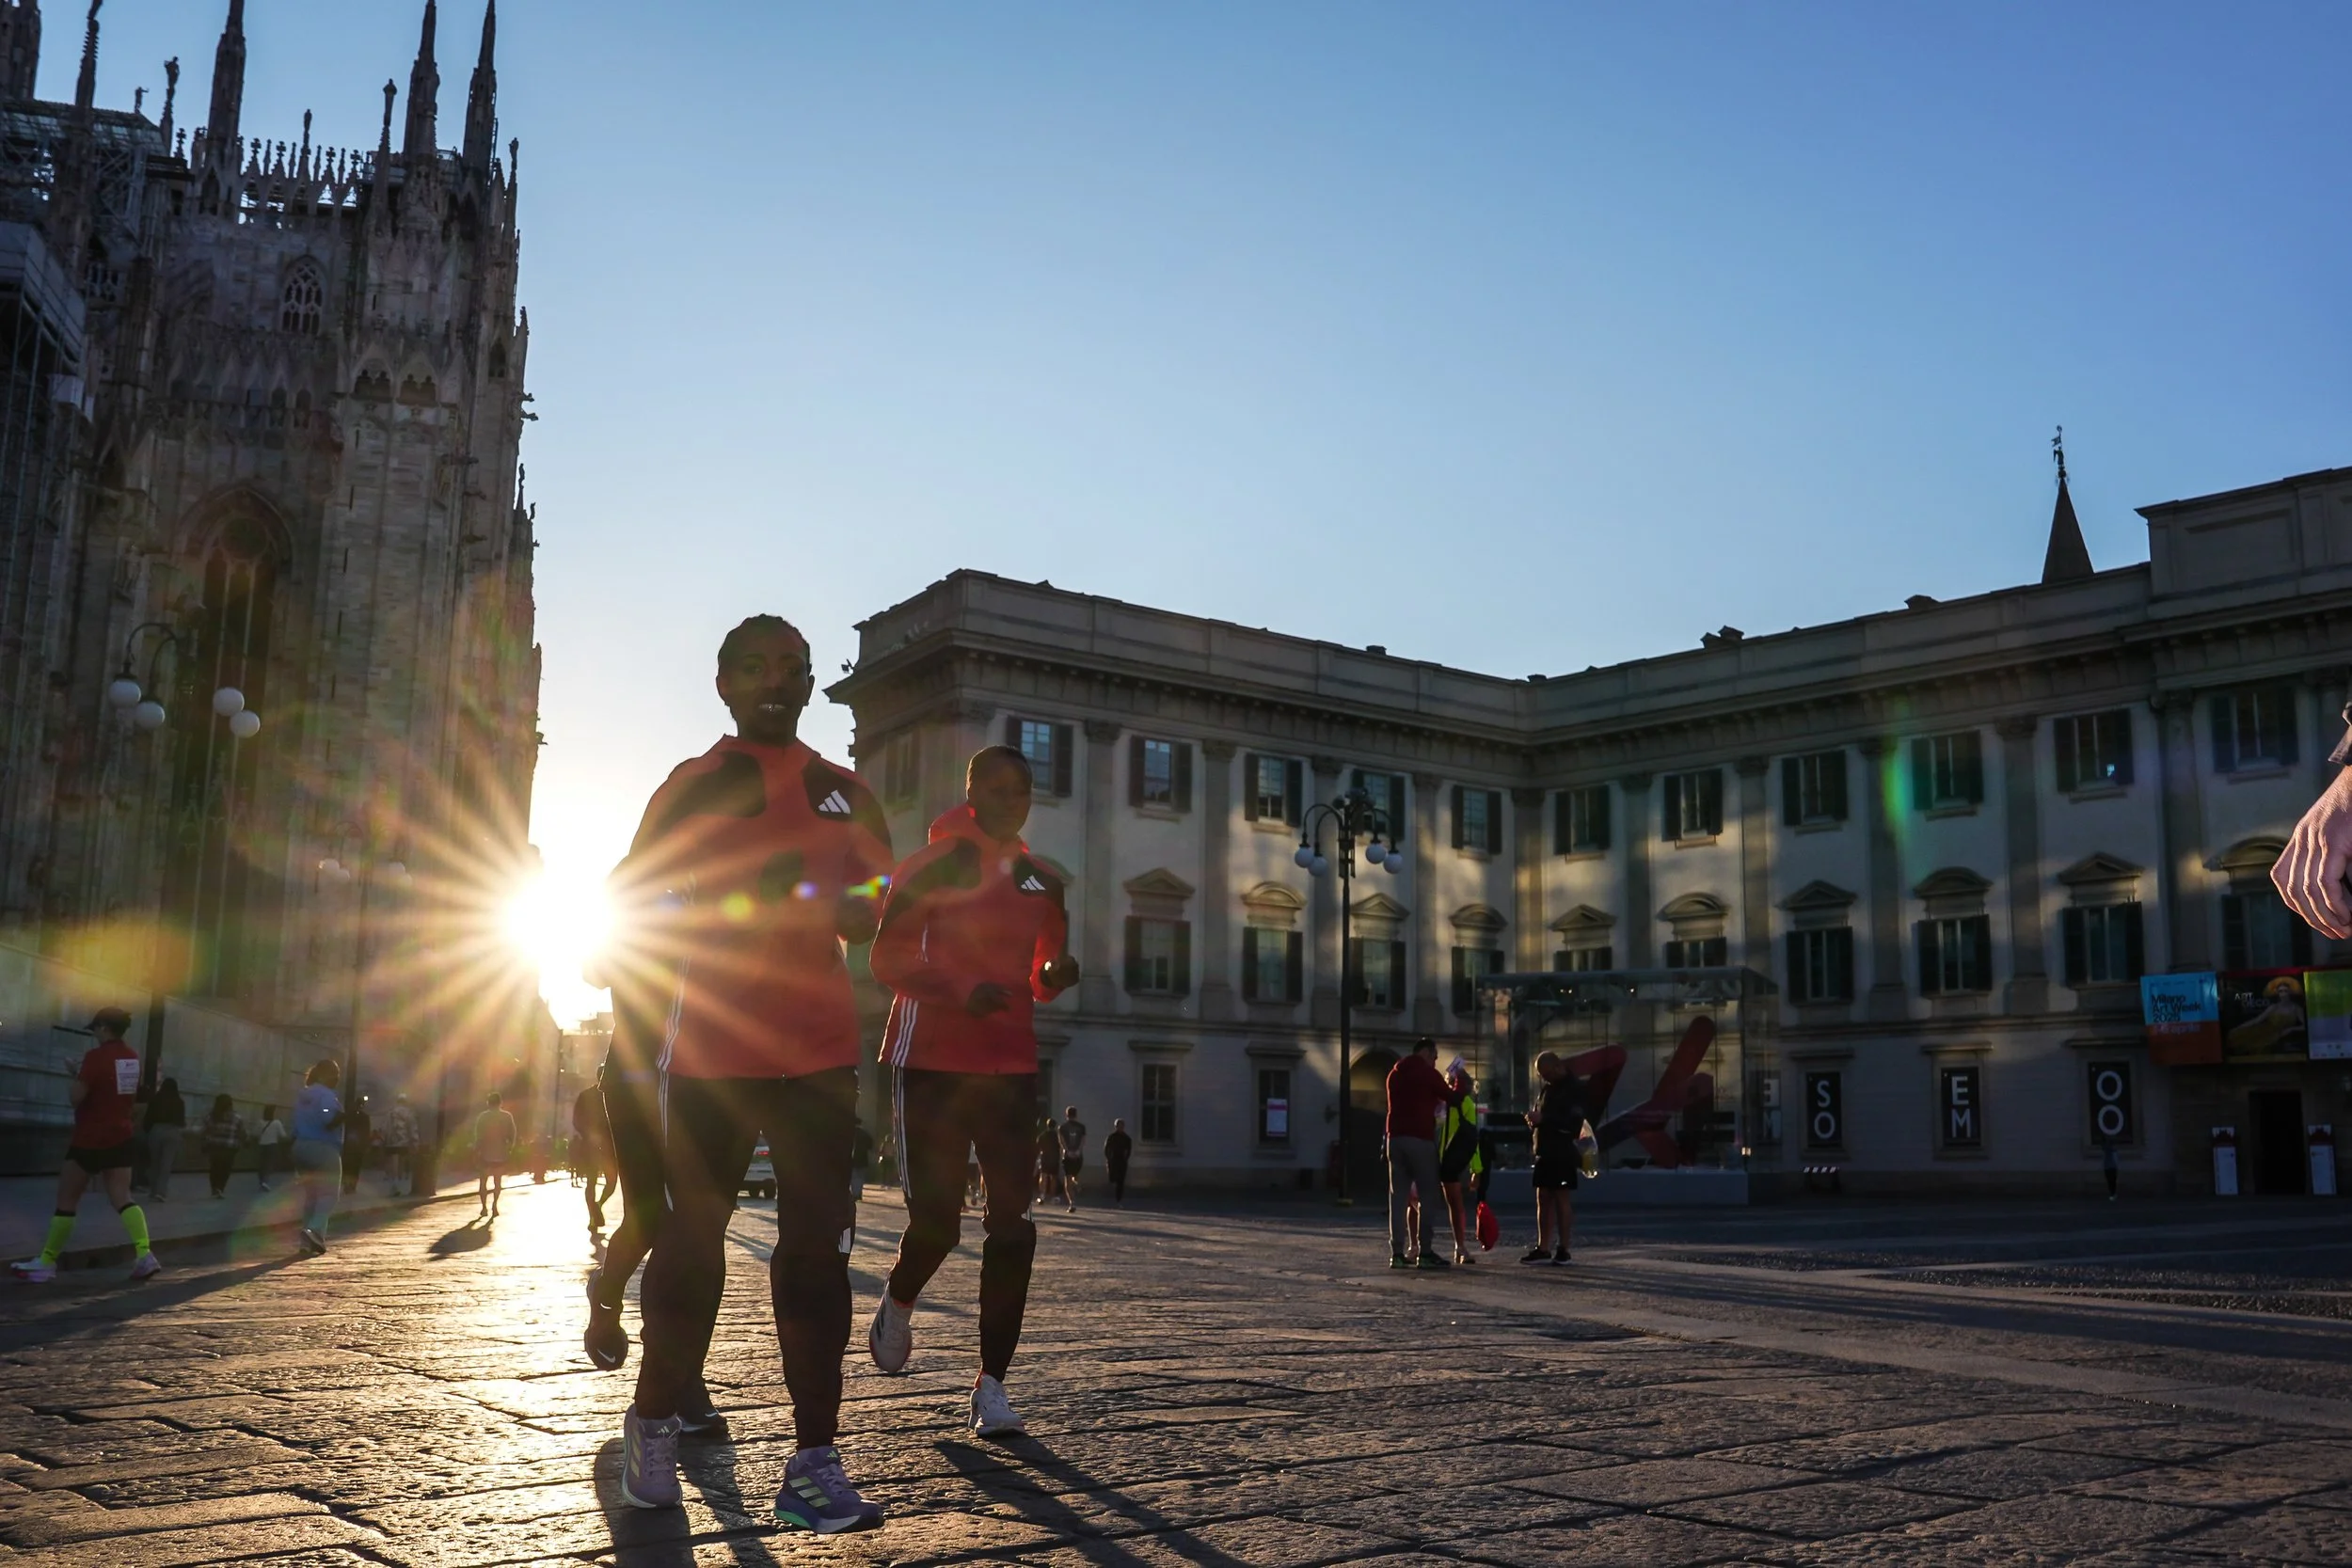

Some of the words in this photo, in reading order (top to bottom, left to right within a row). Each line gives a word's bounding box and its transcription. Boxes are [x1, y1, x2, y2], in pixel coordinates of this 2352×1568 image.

[2151, 993, 2185, 1006] Milano
[2153, 1002, 2168, 1013] Art
[2169, 1001, 2201, 1012] Week
[2153, 1011, 2181, 1022] 2025
